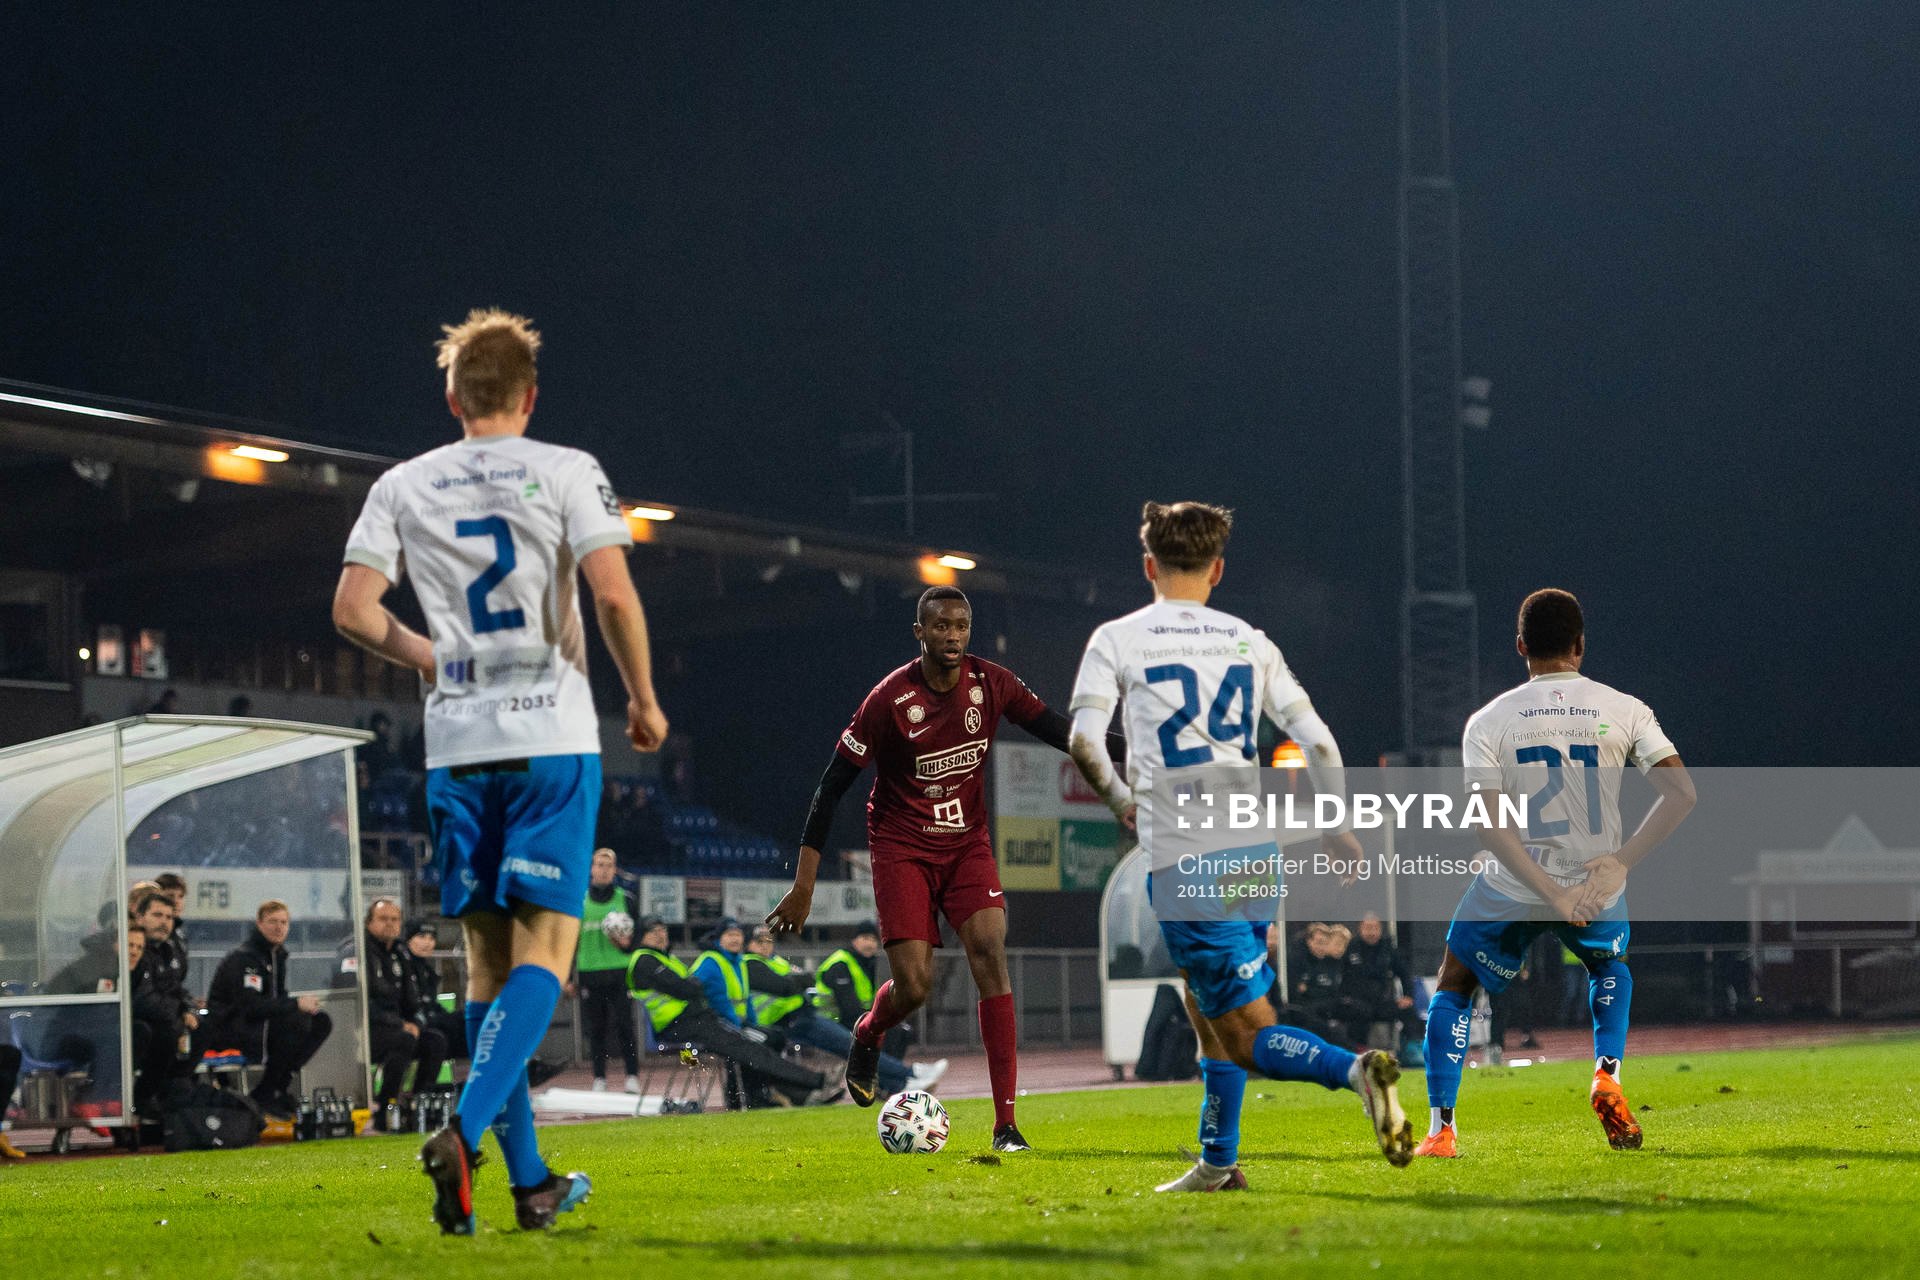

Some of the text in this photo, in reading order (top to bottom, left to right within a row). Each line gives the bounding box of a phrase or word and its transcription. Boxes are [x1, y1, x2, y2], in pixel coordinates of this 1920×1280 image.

[489, 464, 527, 480] Energi
[455, 514, 526, 634] 2
[1147, 624, 1238, 638] Värnamo Energi
[894, 690, 916, 705] stadium
[1144, 663, 1258, 767] 24
[1518, 706, 1600, 719] Värnamo Energi
[843, 735, 864, 754] PULS
[919, 750, 976, 774] OHLSSONS
[1516, 743, 1602, 840] 21
[1597, 994, 1614, 1006] 4
[1267, 1032, 1321, 1064] 4 office
[1446, 1052, 1463, 1064] 4
